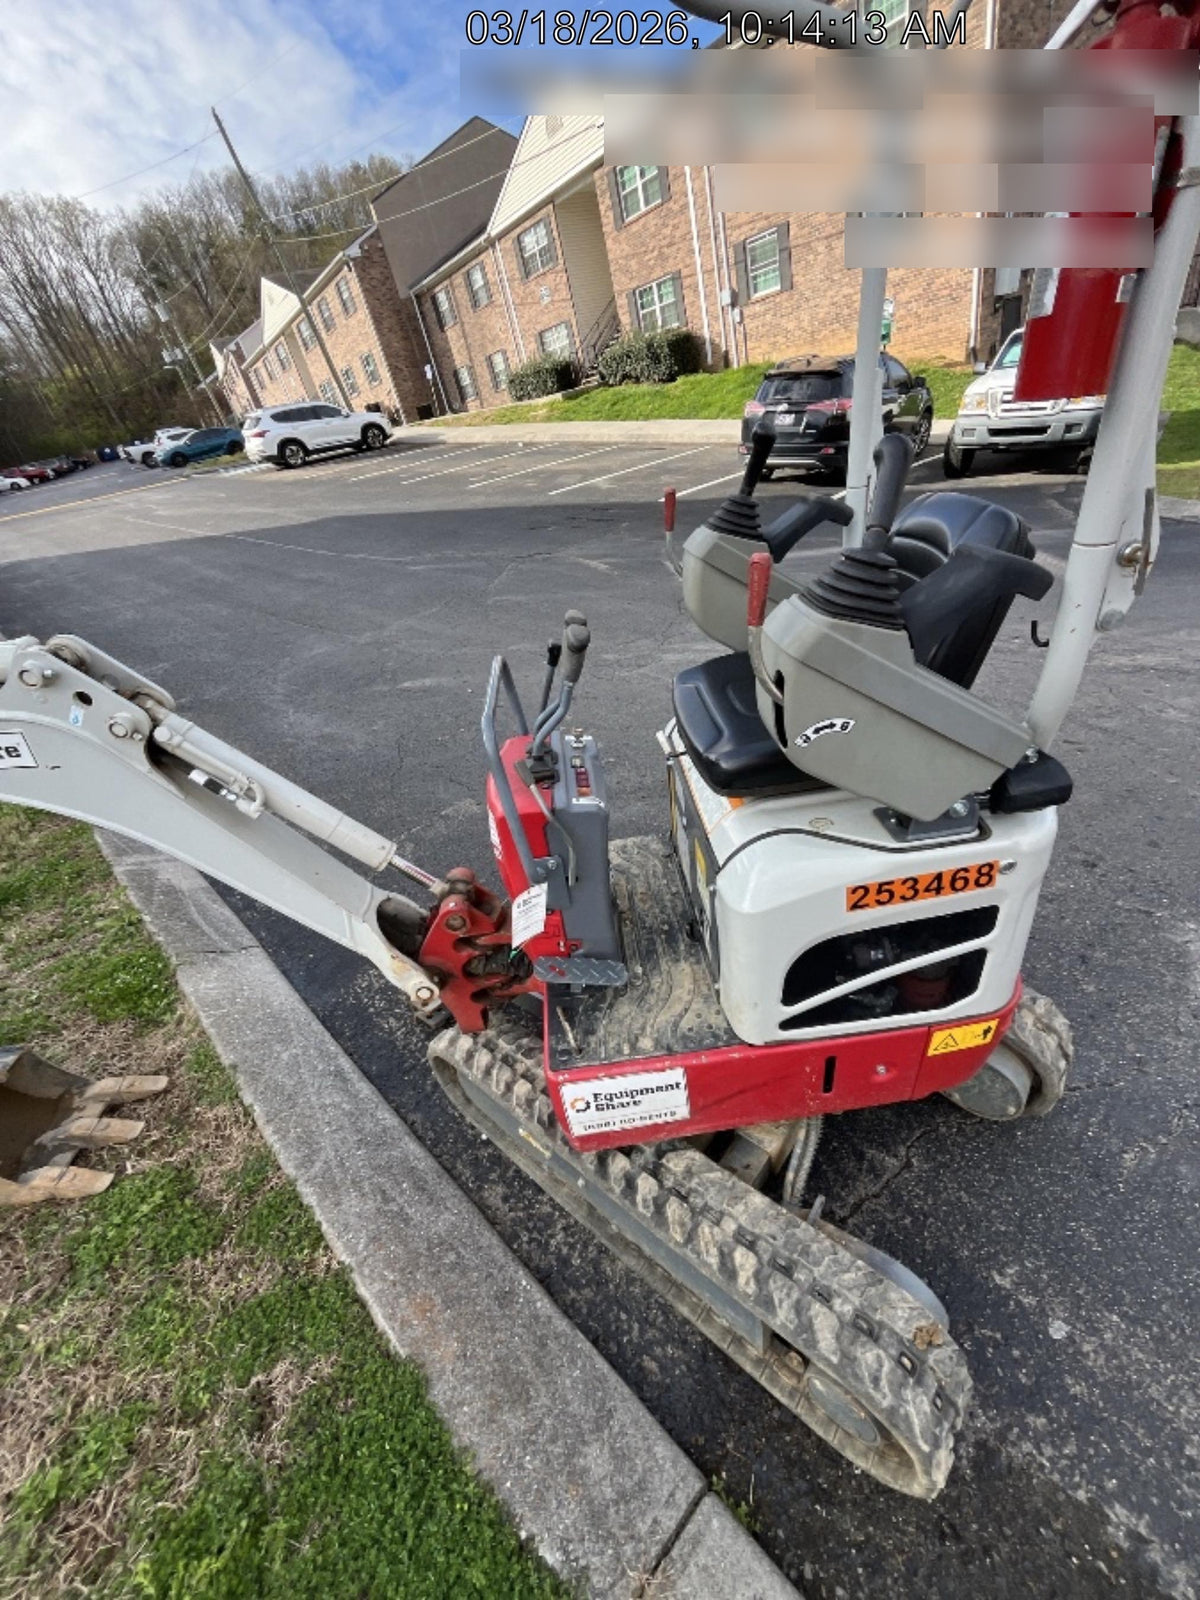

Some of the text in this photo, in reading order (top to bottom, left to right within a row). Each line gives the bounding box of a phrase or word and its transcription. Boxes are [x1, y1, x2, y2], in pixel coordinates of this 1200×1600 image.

[850, 862, 995, 911] 253468
[592, 1081, 682, 1103] Equipment
[594, 1099, 642, 1112] Share
